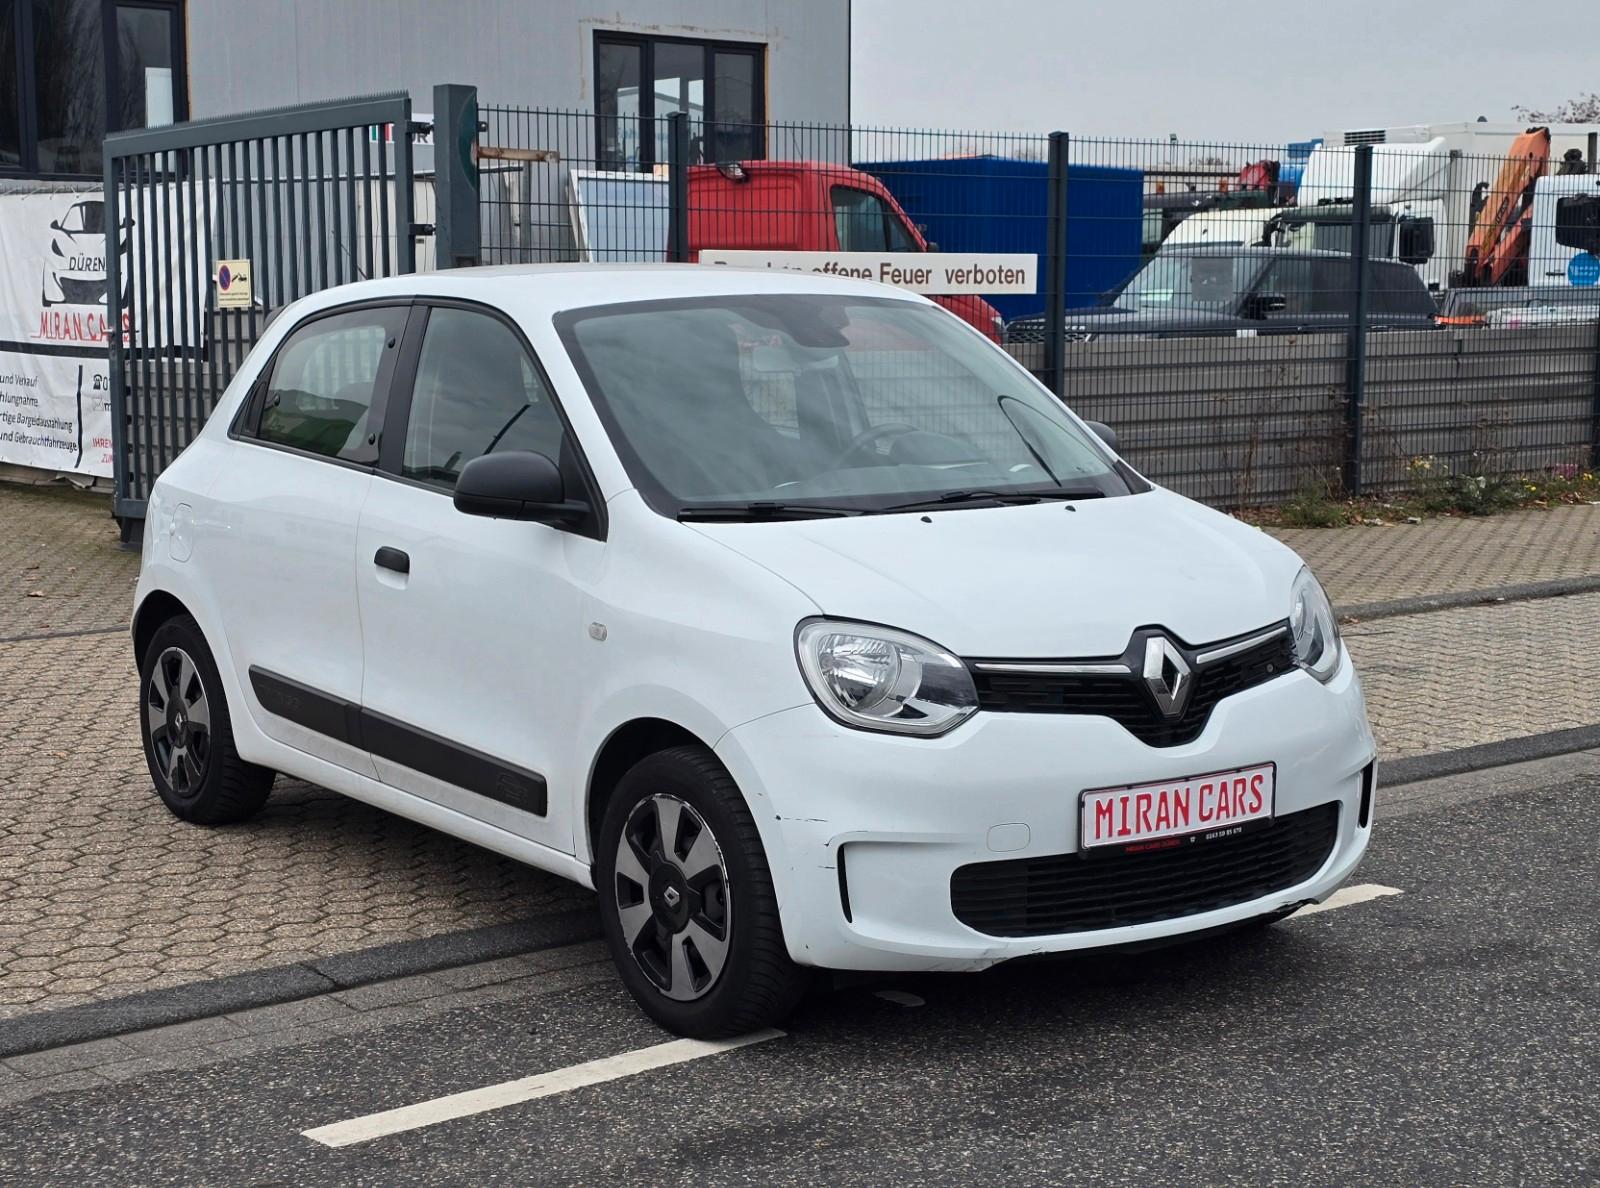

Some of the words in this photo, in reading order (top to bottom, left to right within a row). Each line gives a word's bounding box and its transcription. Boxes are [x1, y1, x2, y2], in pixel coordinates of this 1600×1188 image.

[68, 252, 106, 271] DÜREN
[879, 262, 932, 285] Feuer
[945, 264, 1026, 285] verboten
[40, 311, 83, 340] MIRAN
[87, 312, 129, 341] CAS
[1095, 788, 1190, 840] MIRAN
[1199, 774, 1264, 822] CARS
